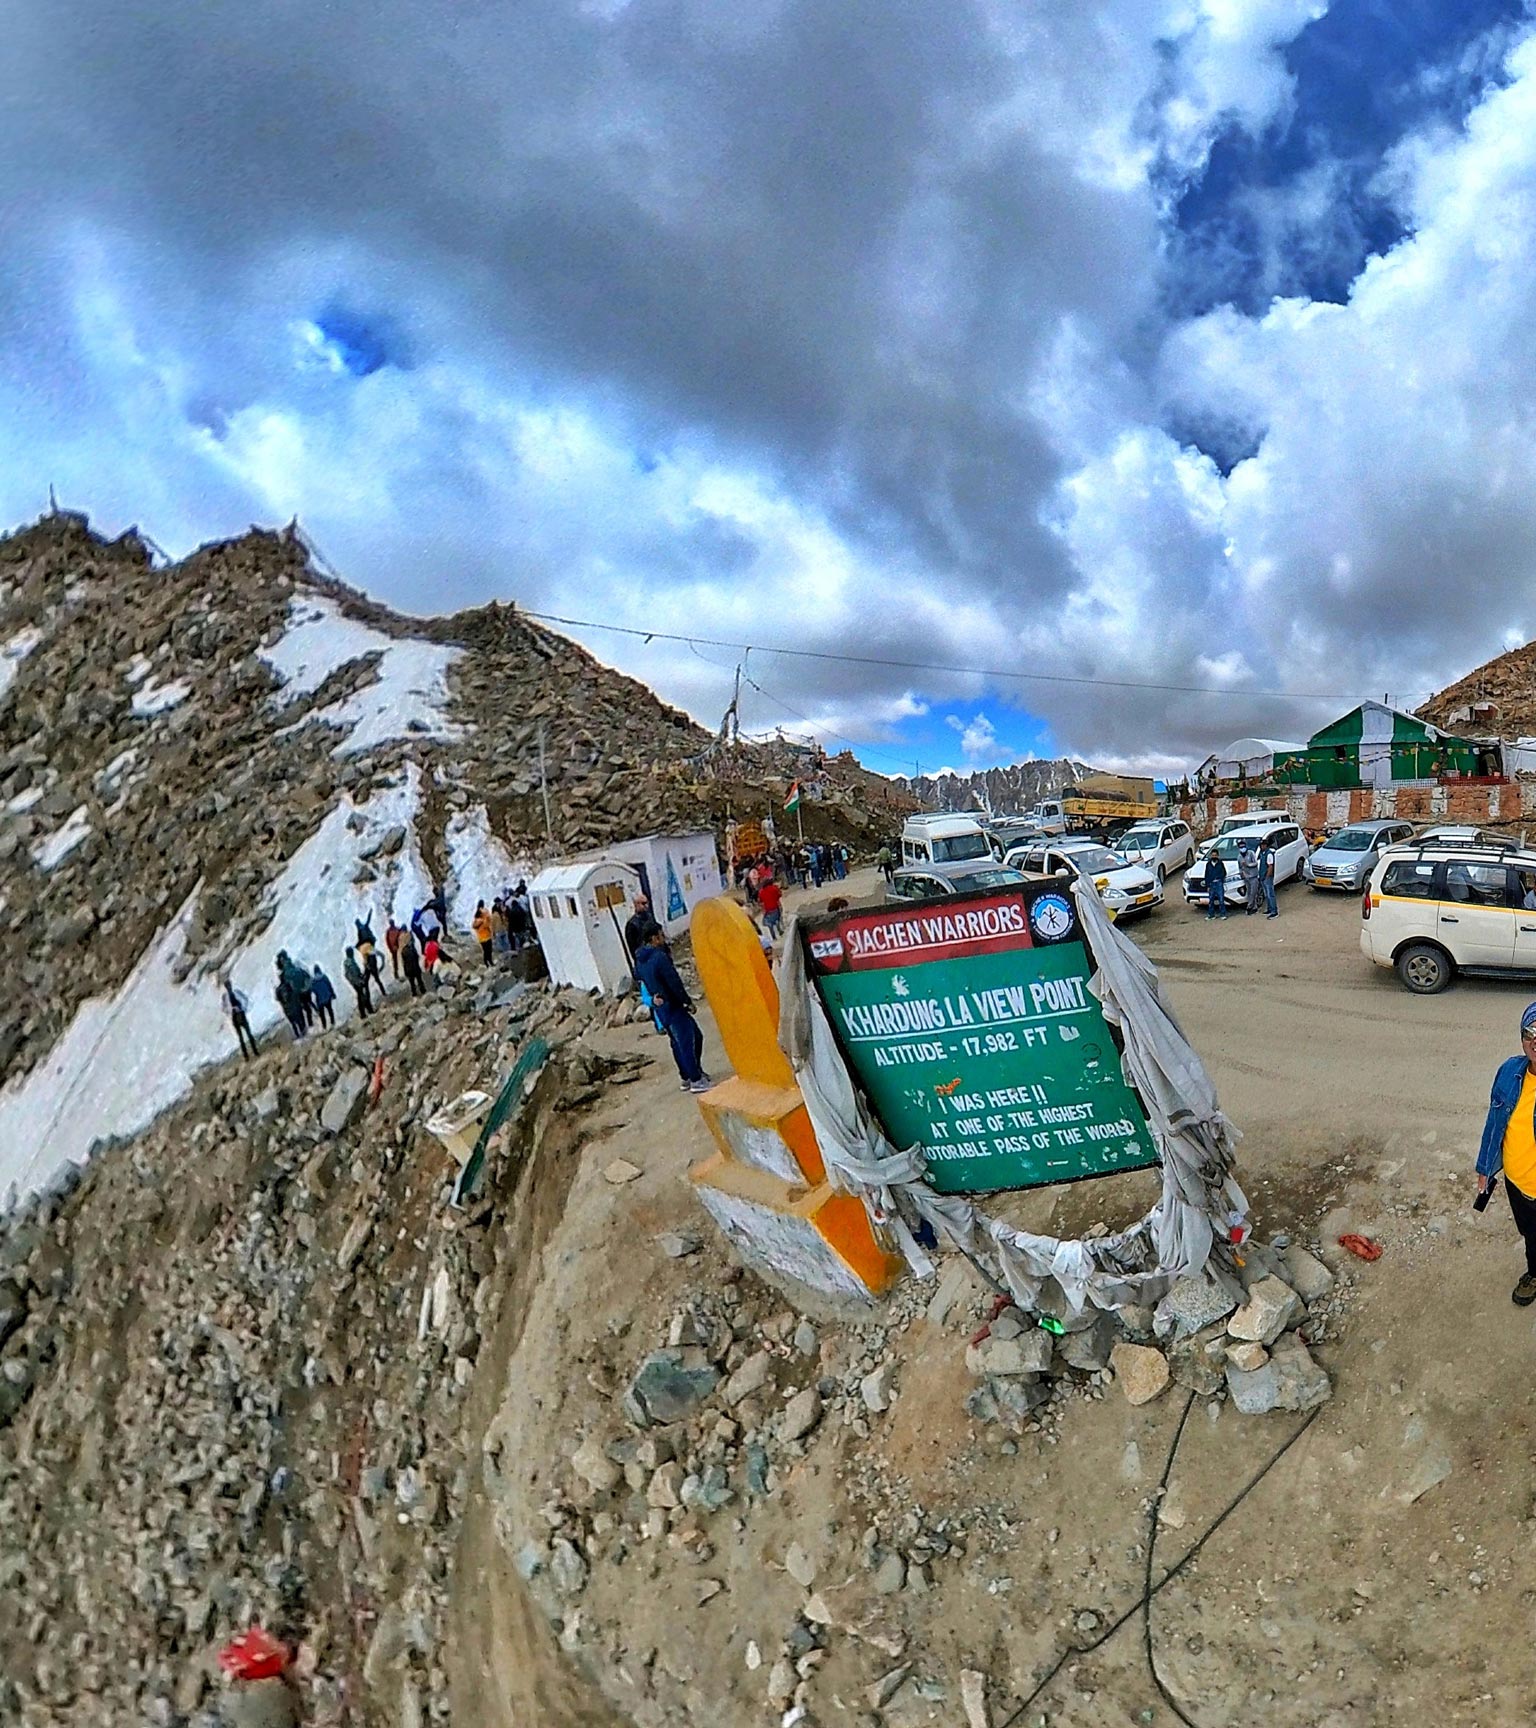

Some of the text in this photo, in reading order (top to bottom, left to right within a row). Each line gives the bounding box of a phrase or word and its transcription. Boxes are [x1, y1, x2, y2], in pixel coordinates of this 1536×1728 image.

[846, 920, 922, 955] SIACHEN
[922, 904, 1024, 943] WARRIORS
[840, 976, 1087, 1036] KHARDUNG LA VIEW POINT
[873, 1041, 948, 1067] ALTITUDE
[961, 1031, 1019, 1057] 17,982
[1022, 1025, 1048, 1048] FT
[938, 1096, 948, 1115] I
[948, 1093, 986, 1113] WAS
[985, 1086, 1032, 1109] HERE
[930, 1102, 1094, 1139] AT ONE OF THE HIGHEST
[993, 1135, 1031, 1155] PASS
[1031, 1131, 1050, 1149] OF
[1053, 1127, 1085, 1146] THE
[1084, 1118, 1136, 1141] WORLD
